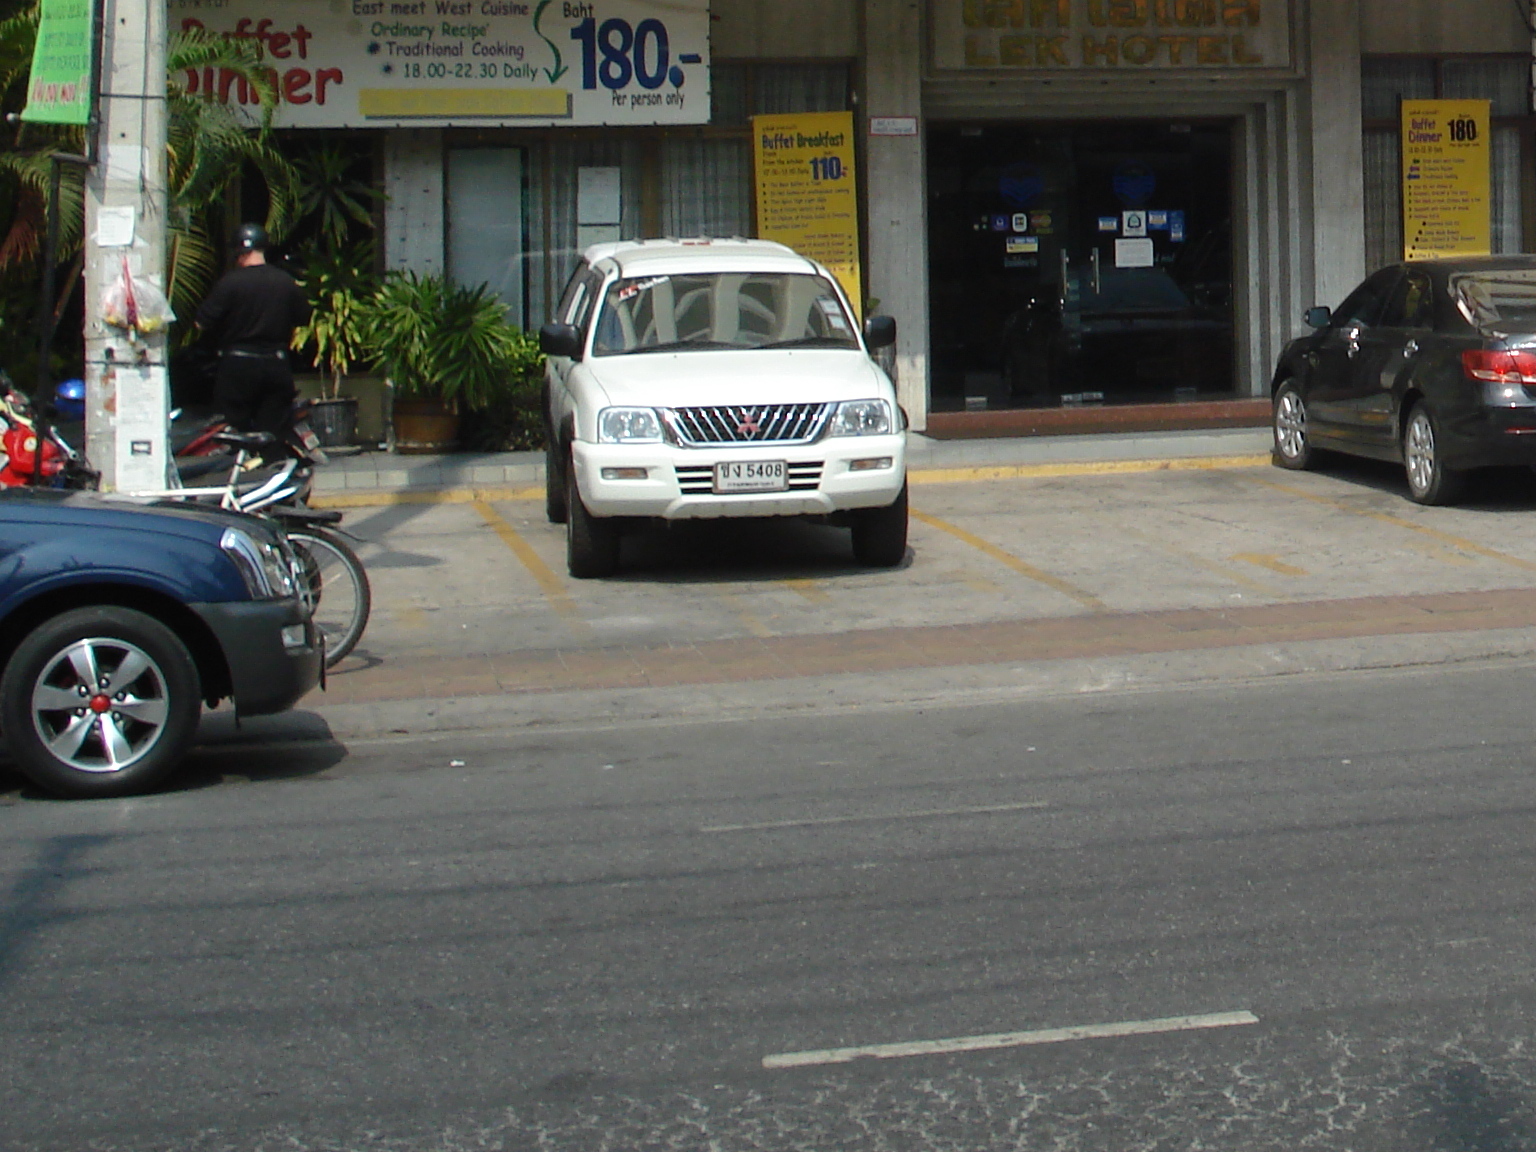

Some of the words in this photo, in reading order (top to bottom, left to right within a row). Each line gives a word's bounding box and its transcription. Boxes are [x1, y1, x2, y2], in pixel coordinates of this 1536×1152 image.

[390, 1, 430, 17] meet
[434, 0, 472, 16] West
[480, 0, 530, 16] Cuisine
[562, 1, 594, 18] Baht
[370, 21, 435, 42] Ordinary
[385, 41, 464, 58] Traditional
[471, 41, 525, 60] Cooking
[963, 35, 1071, 66] LEK
[1082, 34, 1264, 66] HOTEL
[503, 62, 539, 82] Daily
[612, 89, 628, 107] Per
[630, 91, 663, 109] person
[665, 90, 686, 109] only
[1411, 118, 1437, 131] Buffet
[762, 133, 795, 150] Buffet
[795, 130, 845, 150] Breakfast
[1408, 130, 1443, 144] Dinner
[746, 463, 783, 478] 5408
